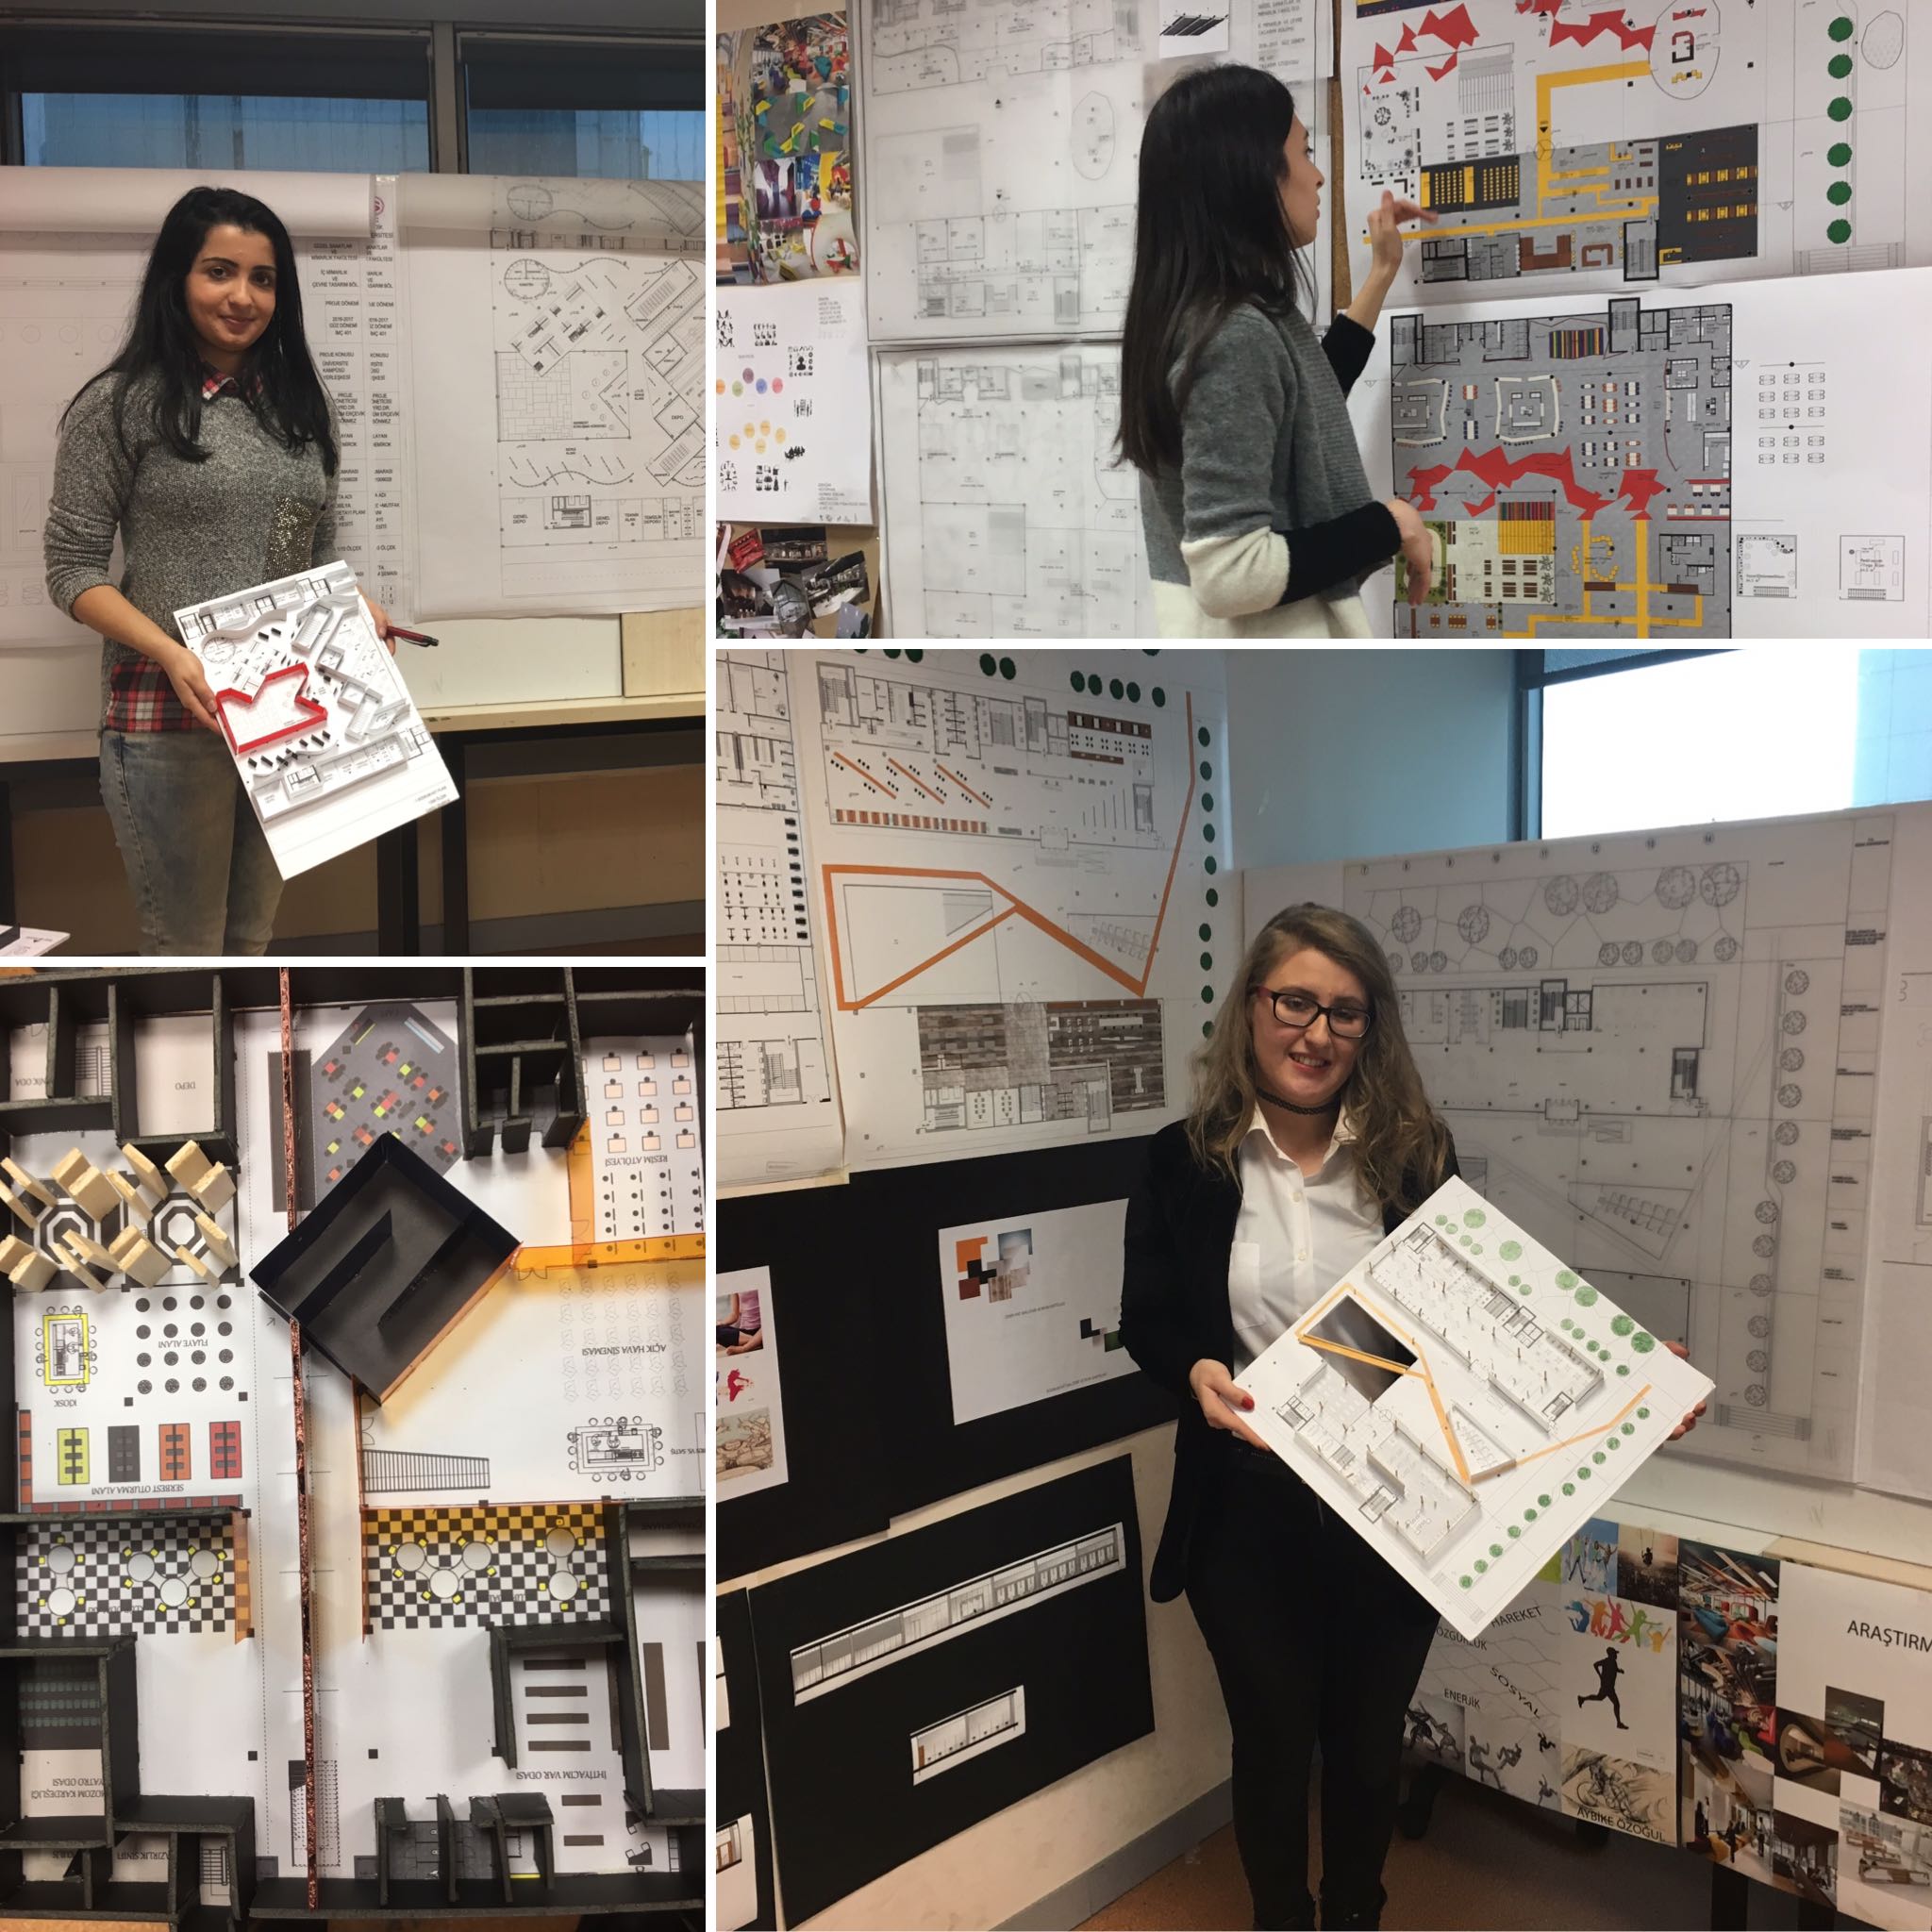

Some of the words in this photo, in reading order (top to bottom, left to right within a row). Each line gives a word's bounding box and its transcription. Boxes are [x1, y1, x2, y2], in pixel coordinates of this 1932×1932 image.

[175, 1082, 195, 1091] DEPO
[605, 1156, 641, 1167] ATÖLYESİ
[643, 1155, 668, 1163] RESİM
[158, 1340, 182, 1349] ALANI
[646, 1343, 666, 1353] AÇIK
[582, 1346, 620, 1356] SİNEMASI
[54, 1399, 77, 1407] KİOSK
[92, 1486, 117, 1495] ALANI
[117, 1485, 151, 1493] OTURMA
[152, 1484, 184, 1492] SERBEST
[1490, 1667, 1541, 1720] SOSYAL
[516, 1771, 542, 1780] ODASI
[543, 1771, 561, 1779] VAR
[563, 1770, 607, 1780] İHTİYACIM
[1616, 1819, 1665, 1842] ÖZOĞUL
